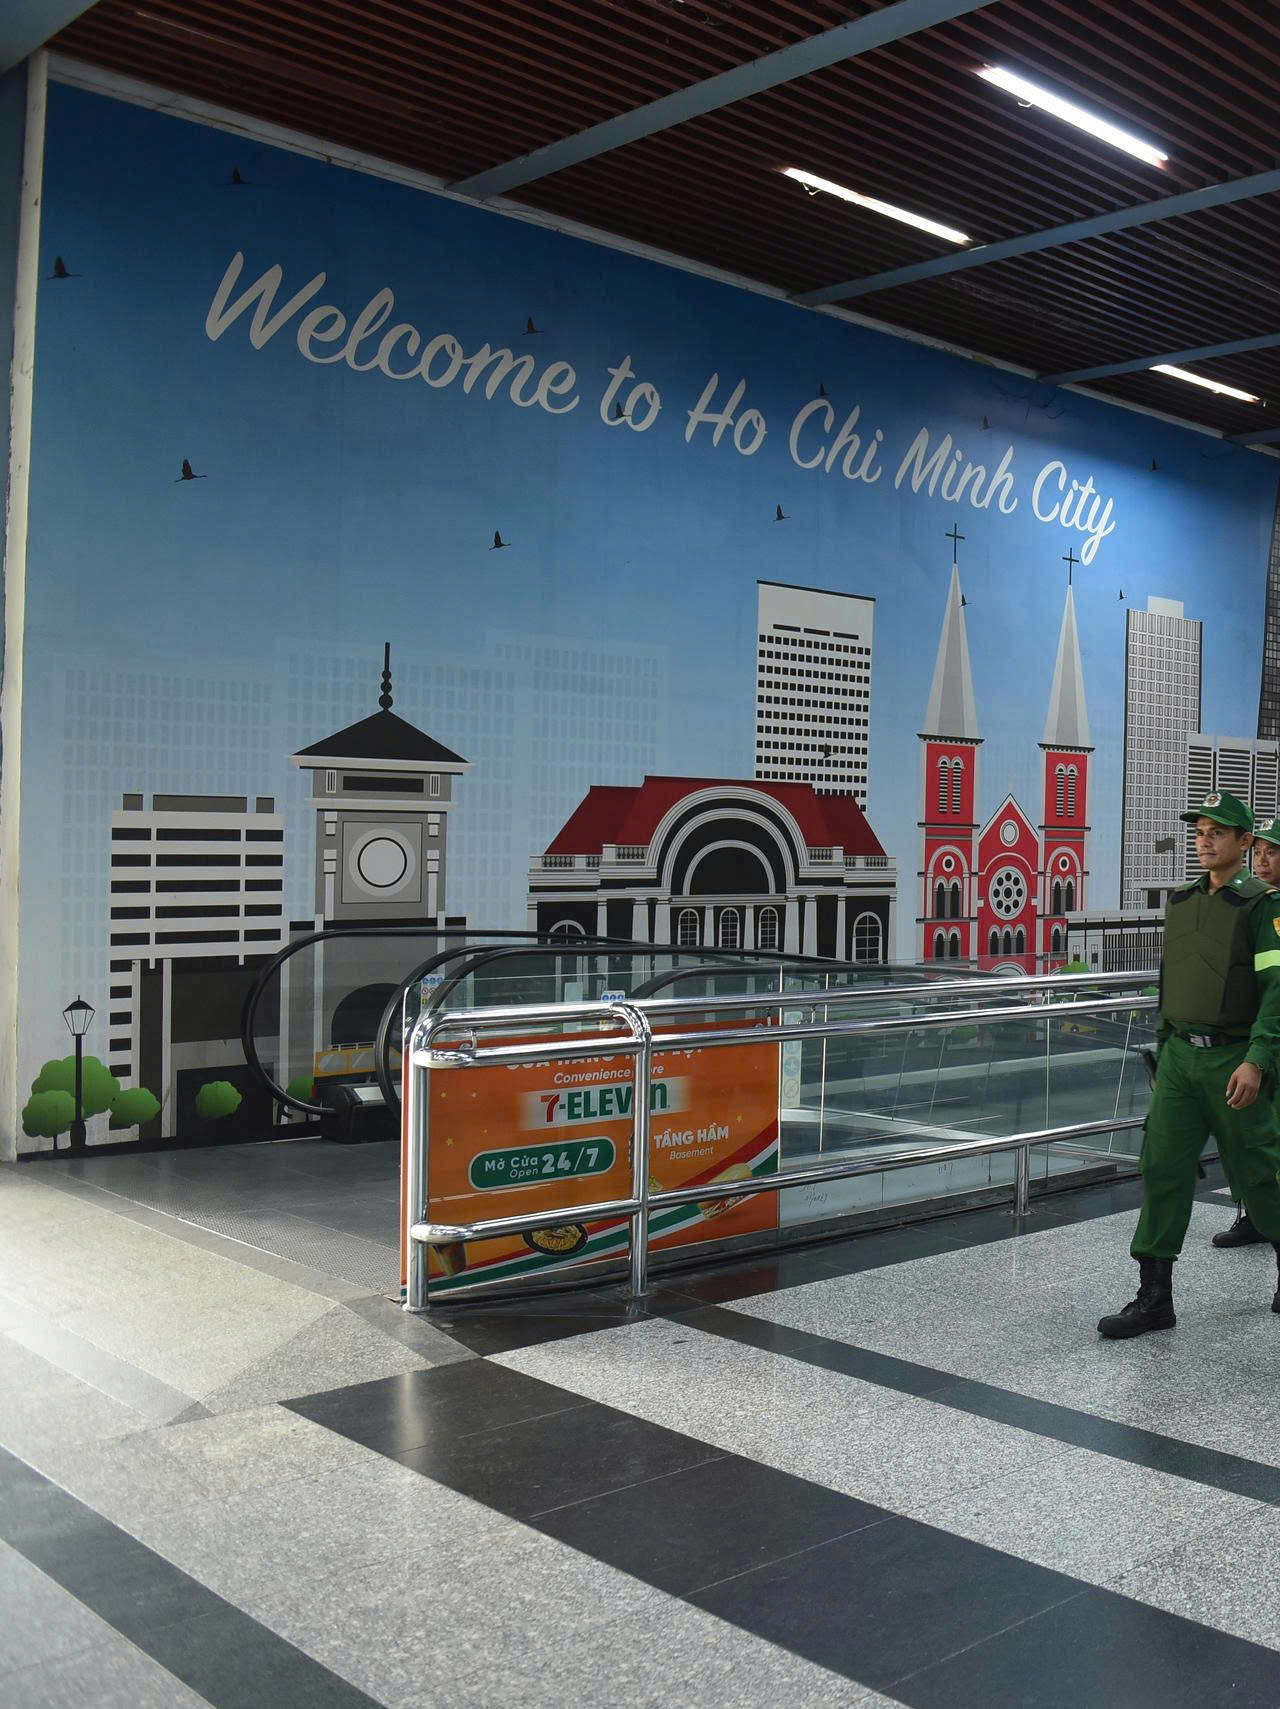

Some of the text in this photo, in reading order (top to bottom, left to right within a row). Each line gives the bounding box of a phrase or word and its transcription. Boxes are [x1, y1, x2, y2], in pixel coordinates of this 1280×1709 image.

[205, 251, 1116, 566] Welcome to Ho Chi Minh City
[553, 1069, 632, 1084] Convenience
[540, 1082, 668, 1123] 7-ELEVn
[654, 1122, 729, 1149] TẦNG HẦM
[485, 1147, 599, 1174] Mở Cửa 24/7
[670, 1146, 713, 1160] Basement
[509, 1167, 539, 1179] Open
